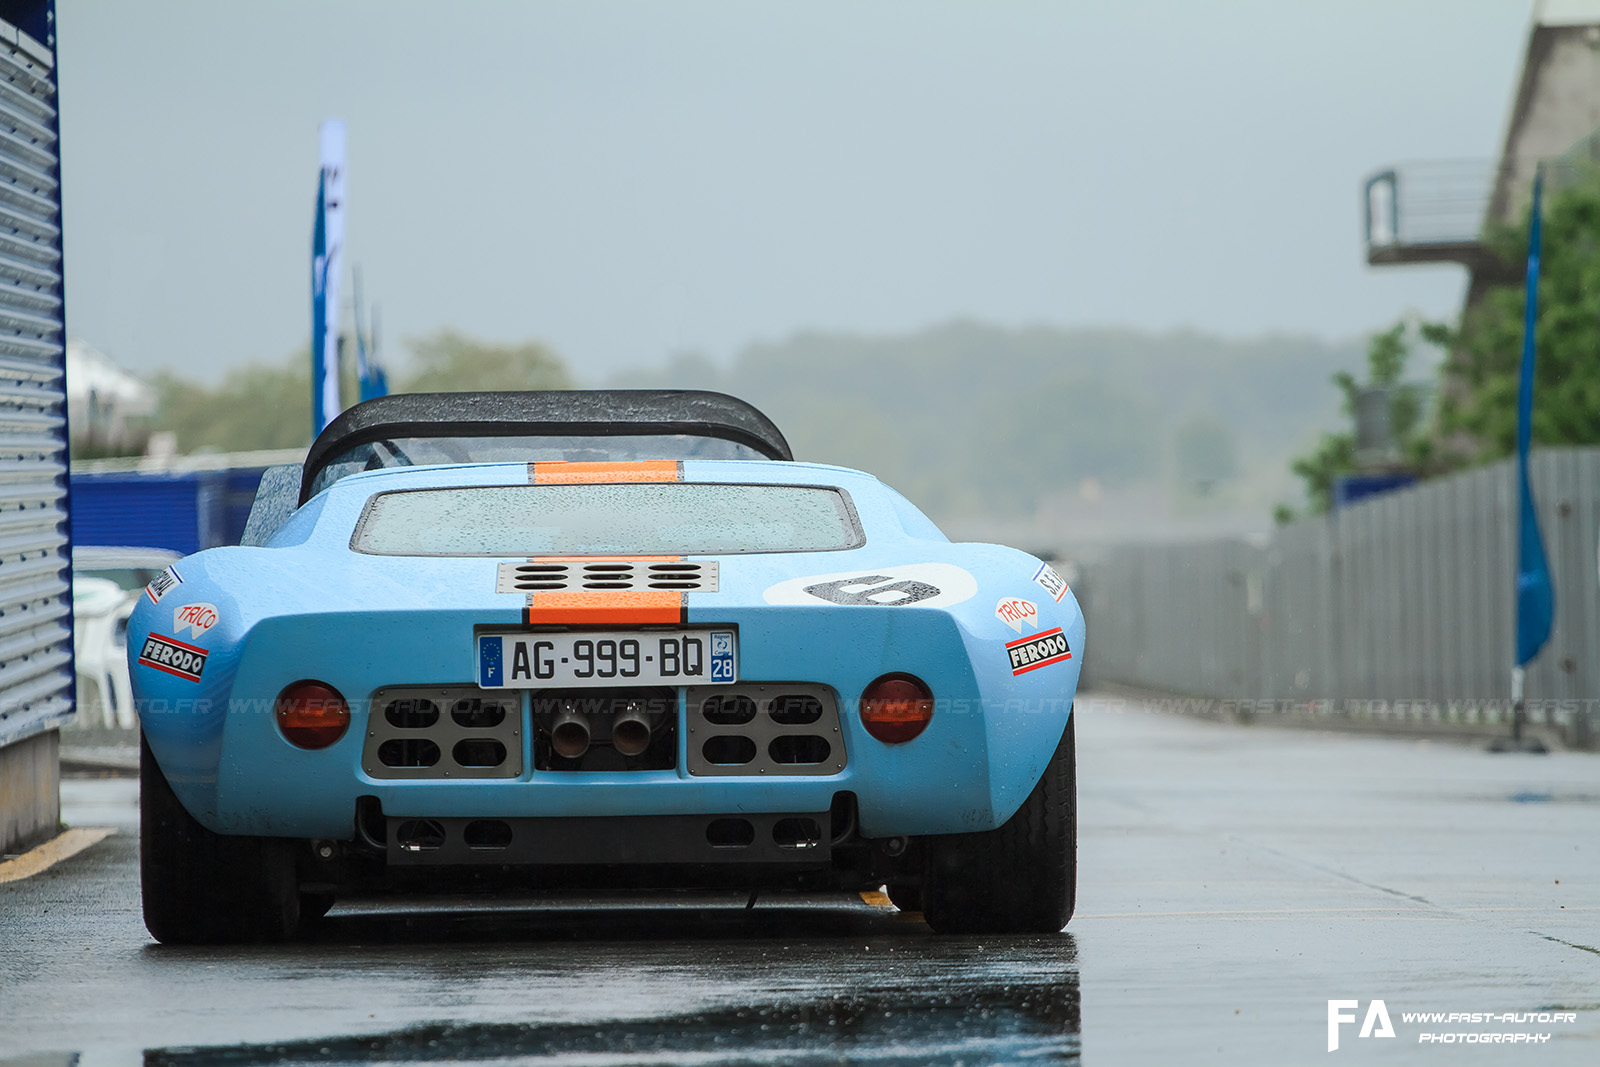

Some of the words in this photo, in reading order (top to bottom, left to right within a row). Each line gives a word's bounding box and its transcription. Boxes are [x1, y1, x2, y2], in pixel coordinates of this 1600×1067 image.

[178, 606, 217, 629] TRICO
[998, 600, 1036, 623] TRICO
[142, 640, 203, 673] FERODO
[511, 638, 703, 680] AG-999-BQ
[1009, 635, 1067, 667] FERODO
[487, 667, 496, 678] F
[712, 659, 733, 678] 28
